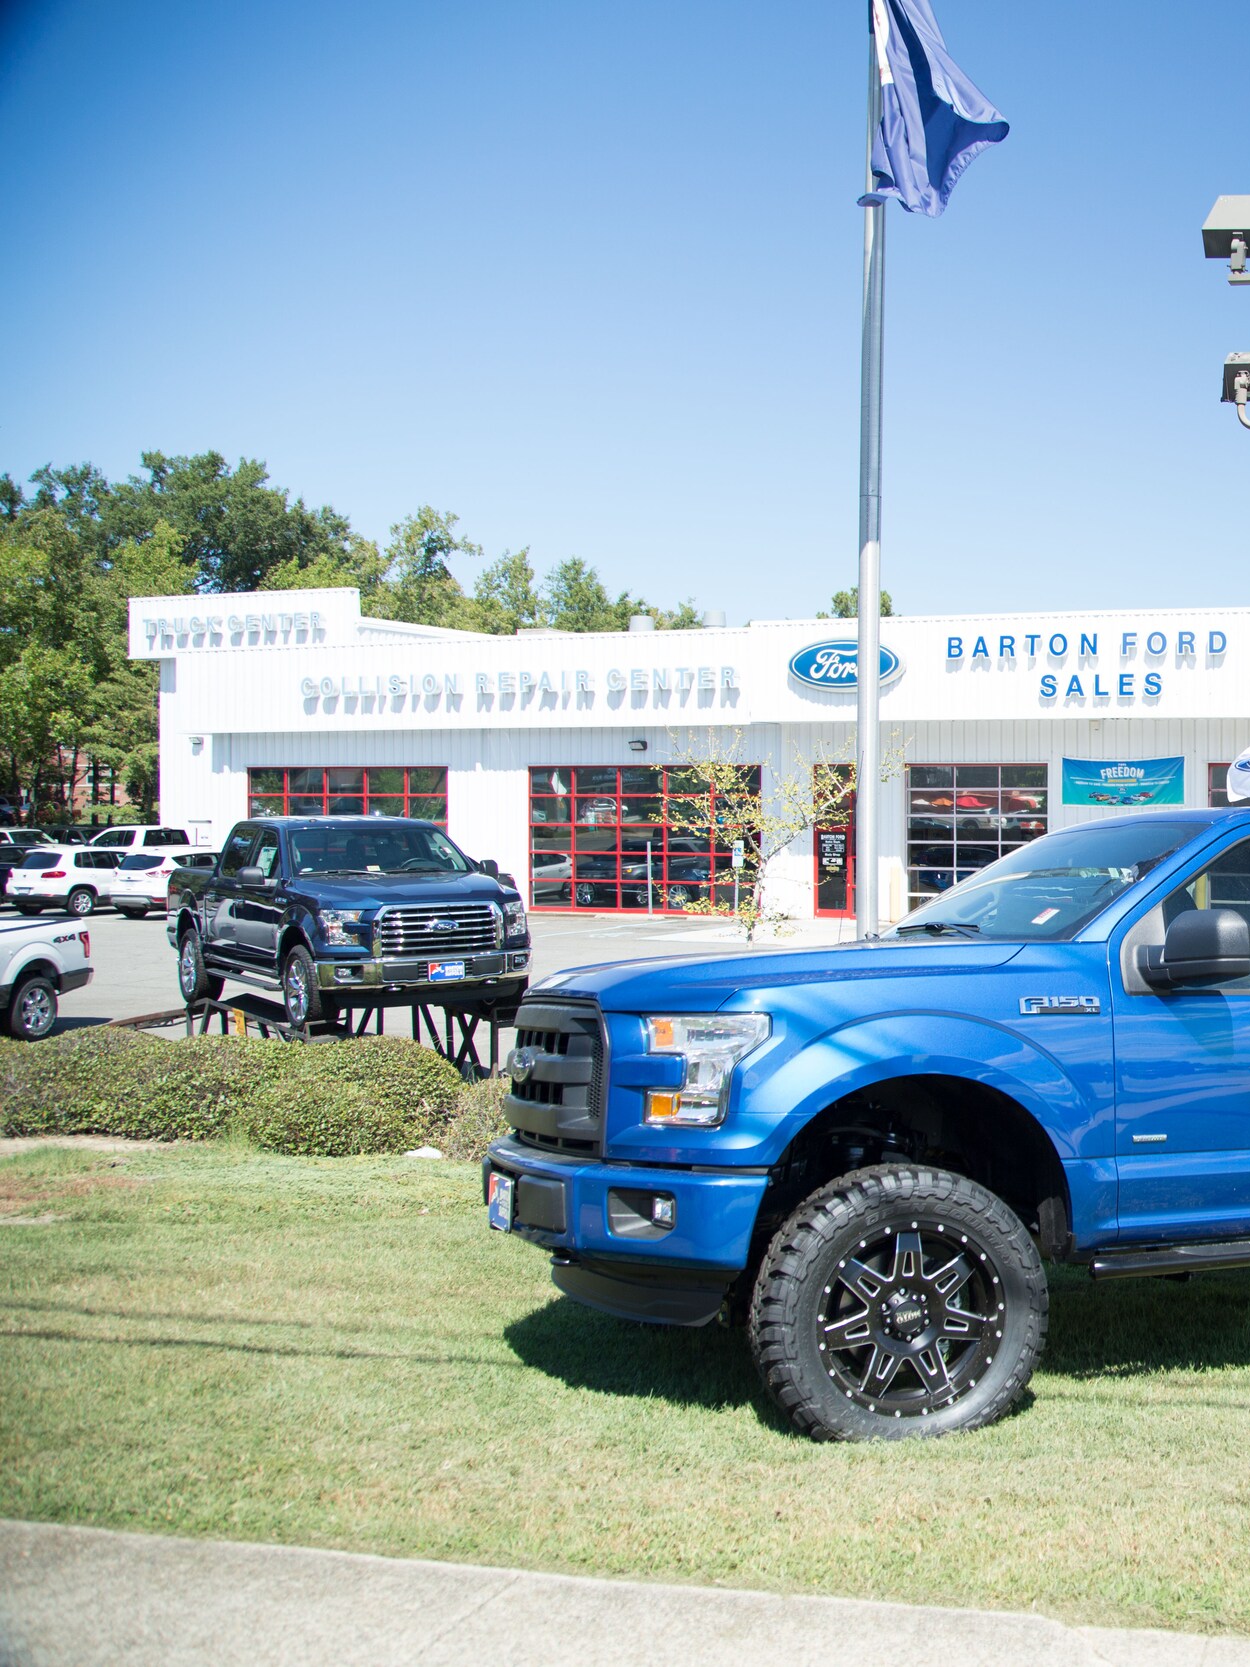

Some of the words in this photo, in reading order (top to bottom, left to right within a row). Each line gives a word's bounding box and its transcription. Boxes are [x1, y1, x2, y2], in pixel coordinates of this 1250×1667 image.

[143, 615, 221, 636] TRUCK
[228, 612, 322, 632] CENTER
[947, 633, 1099, 658] BARTON
[1122, 631, 1228, 655] FORD
[808, 648, 859, 680] For
[300, 673, 460, 697] COLLISION
[475, 670, 590, 693] REPAIR
[606, 666, 736, 690] CENTER
[1040, 672, 1163, 698] SALES
[1100, 766, 1145, 779] FREEDOM
